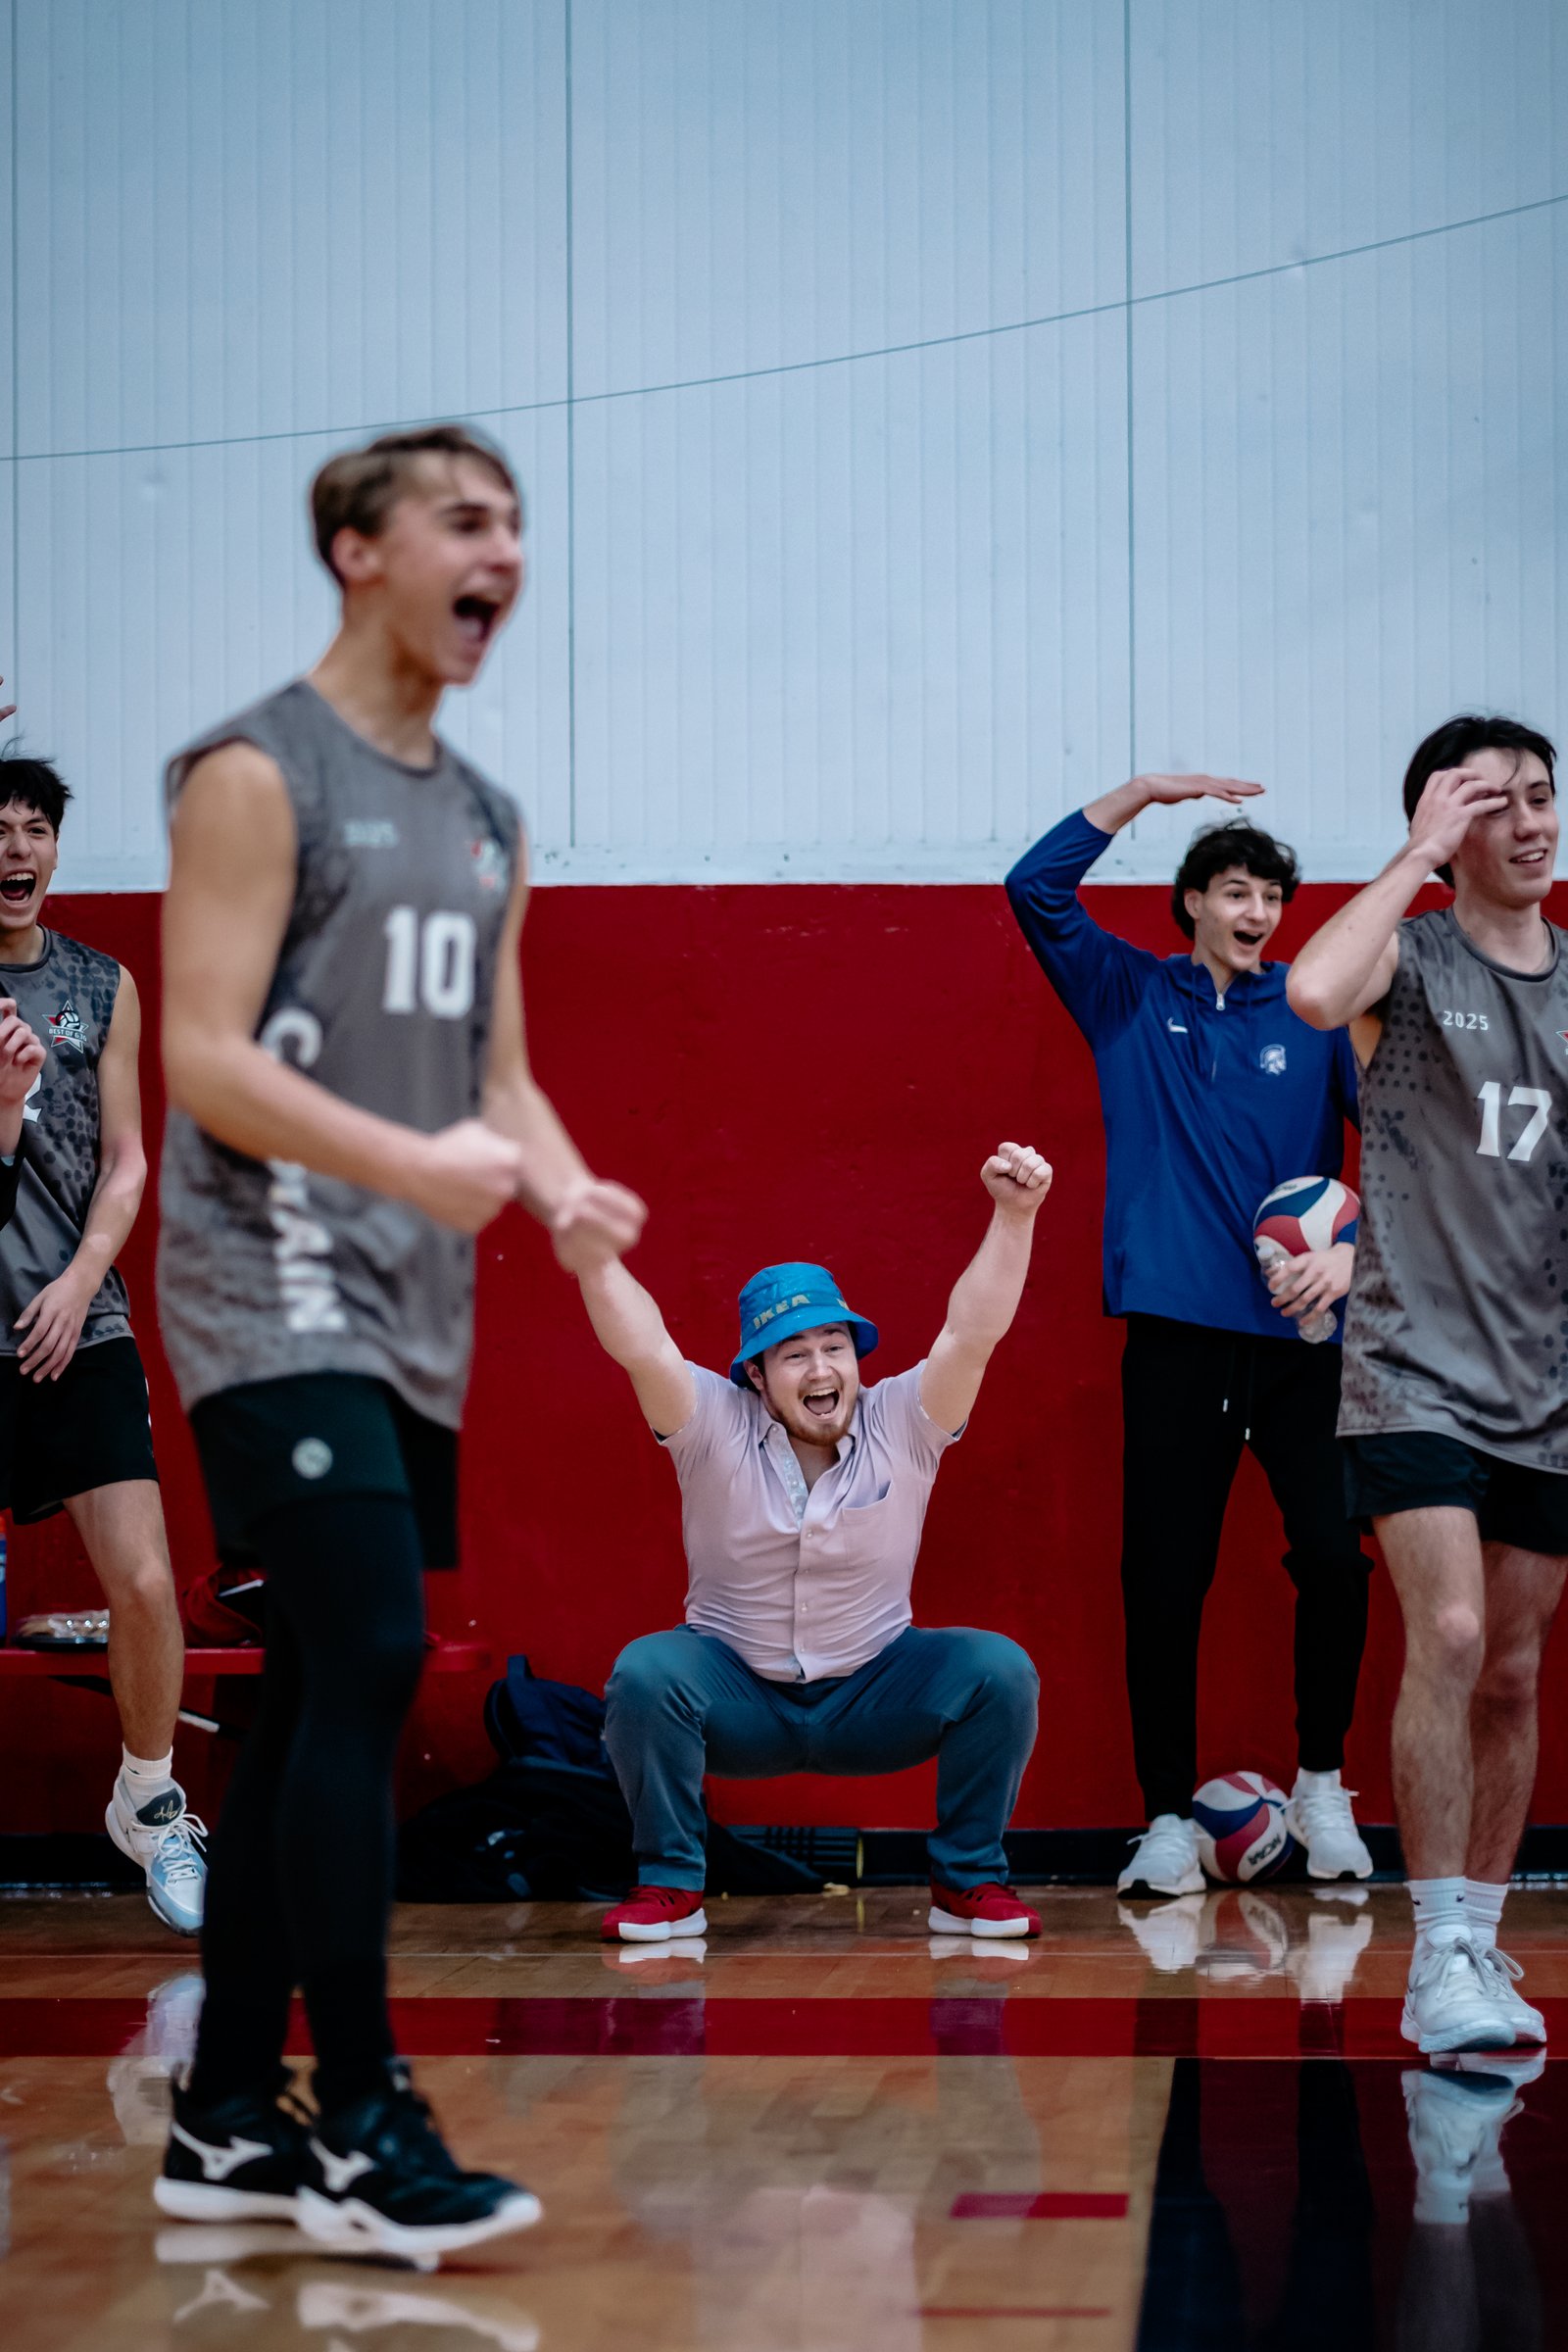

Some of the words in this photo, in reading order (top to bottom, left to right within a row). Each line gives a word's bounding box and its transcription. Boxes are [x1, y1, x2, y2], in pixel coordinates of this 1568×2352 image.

[383, 905, 476, 1020] 10
[1443, 1010, 1489, 1031] 2025
[1476, 1081, 1552, 1162] 17
[753, 1294, 810, 1330] IKEA
